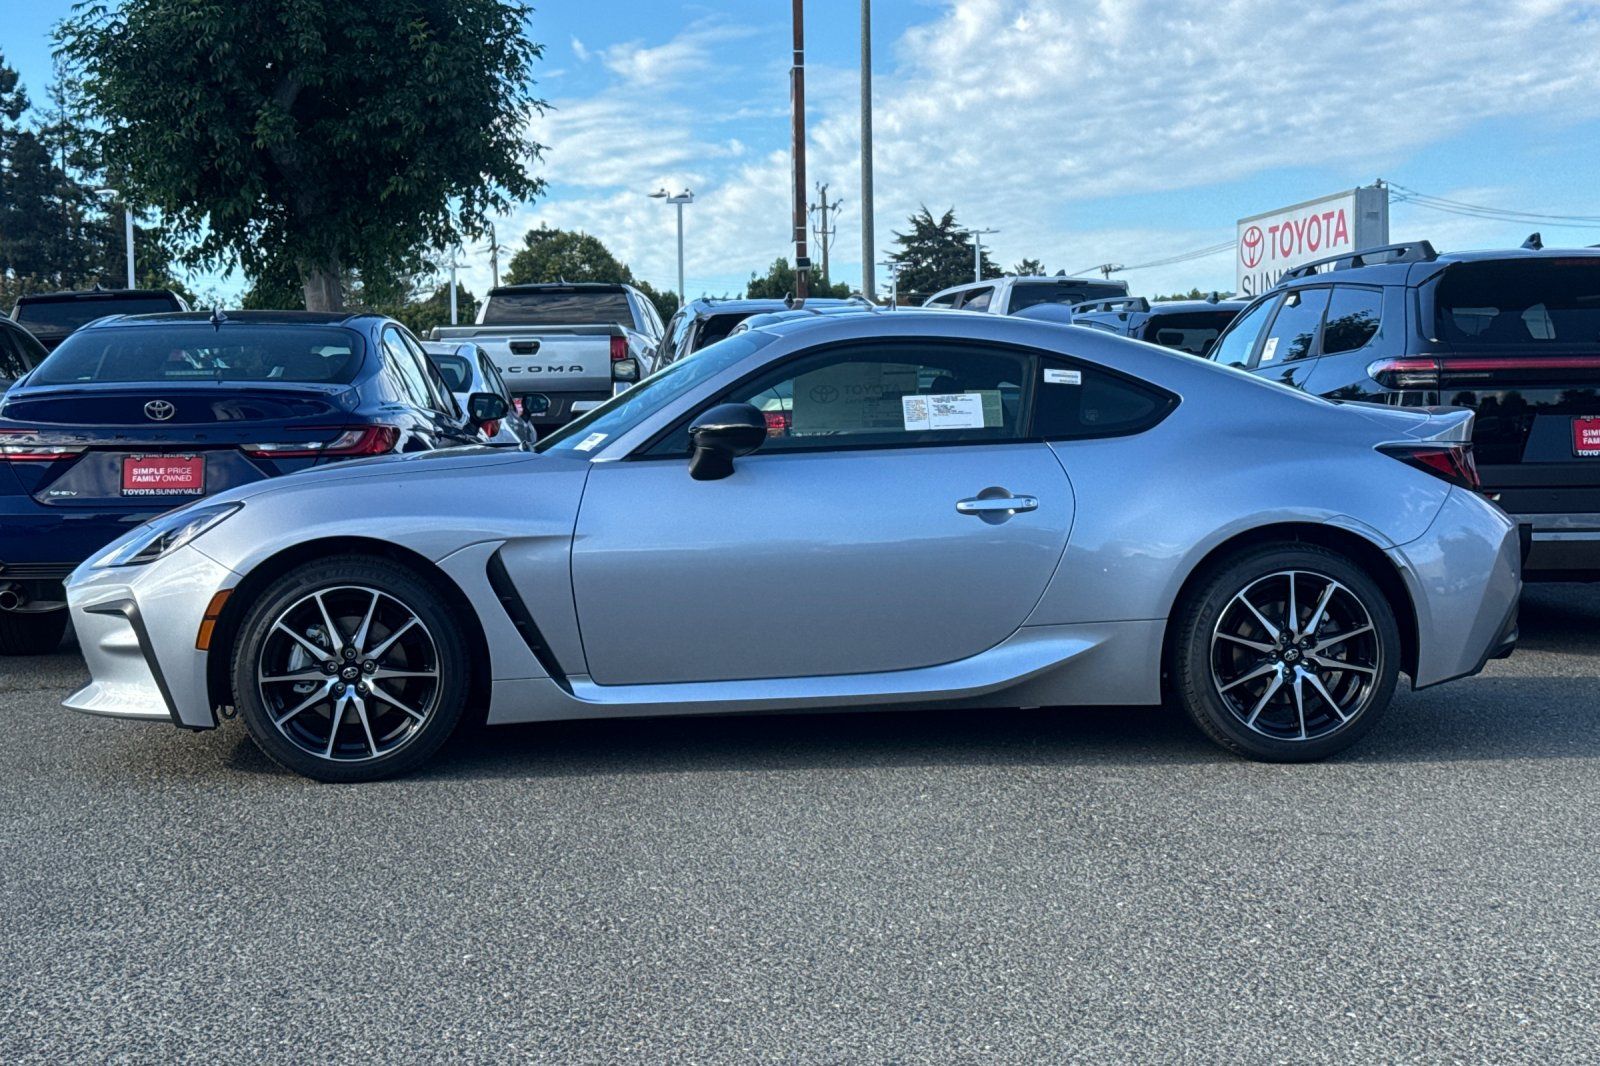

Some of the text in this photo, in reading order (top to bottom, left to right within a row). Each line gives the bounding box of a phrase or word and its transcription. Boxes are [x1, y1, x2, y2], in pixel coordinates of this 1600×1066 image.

[1268, 208, 1349, 260] TOYOTA
[496, 365, 584, 374] COMA
[132, 466, 192, 475] SIMPLE PRICE
[131, 474, 192, 483] FAMILY OWNED
[122, 487, 203, 496] TOYOTA SUNNYVALE
